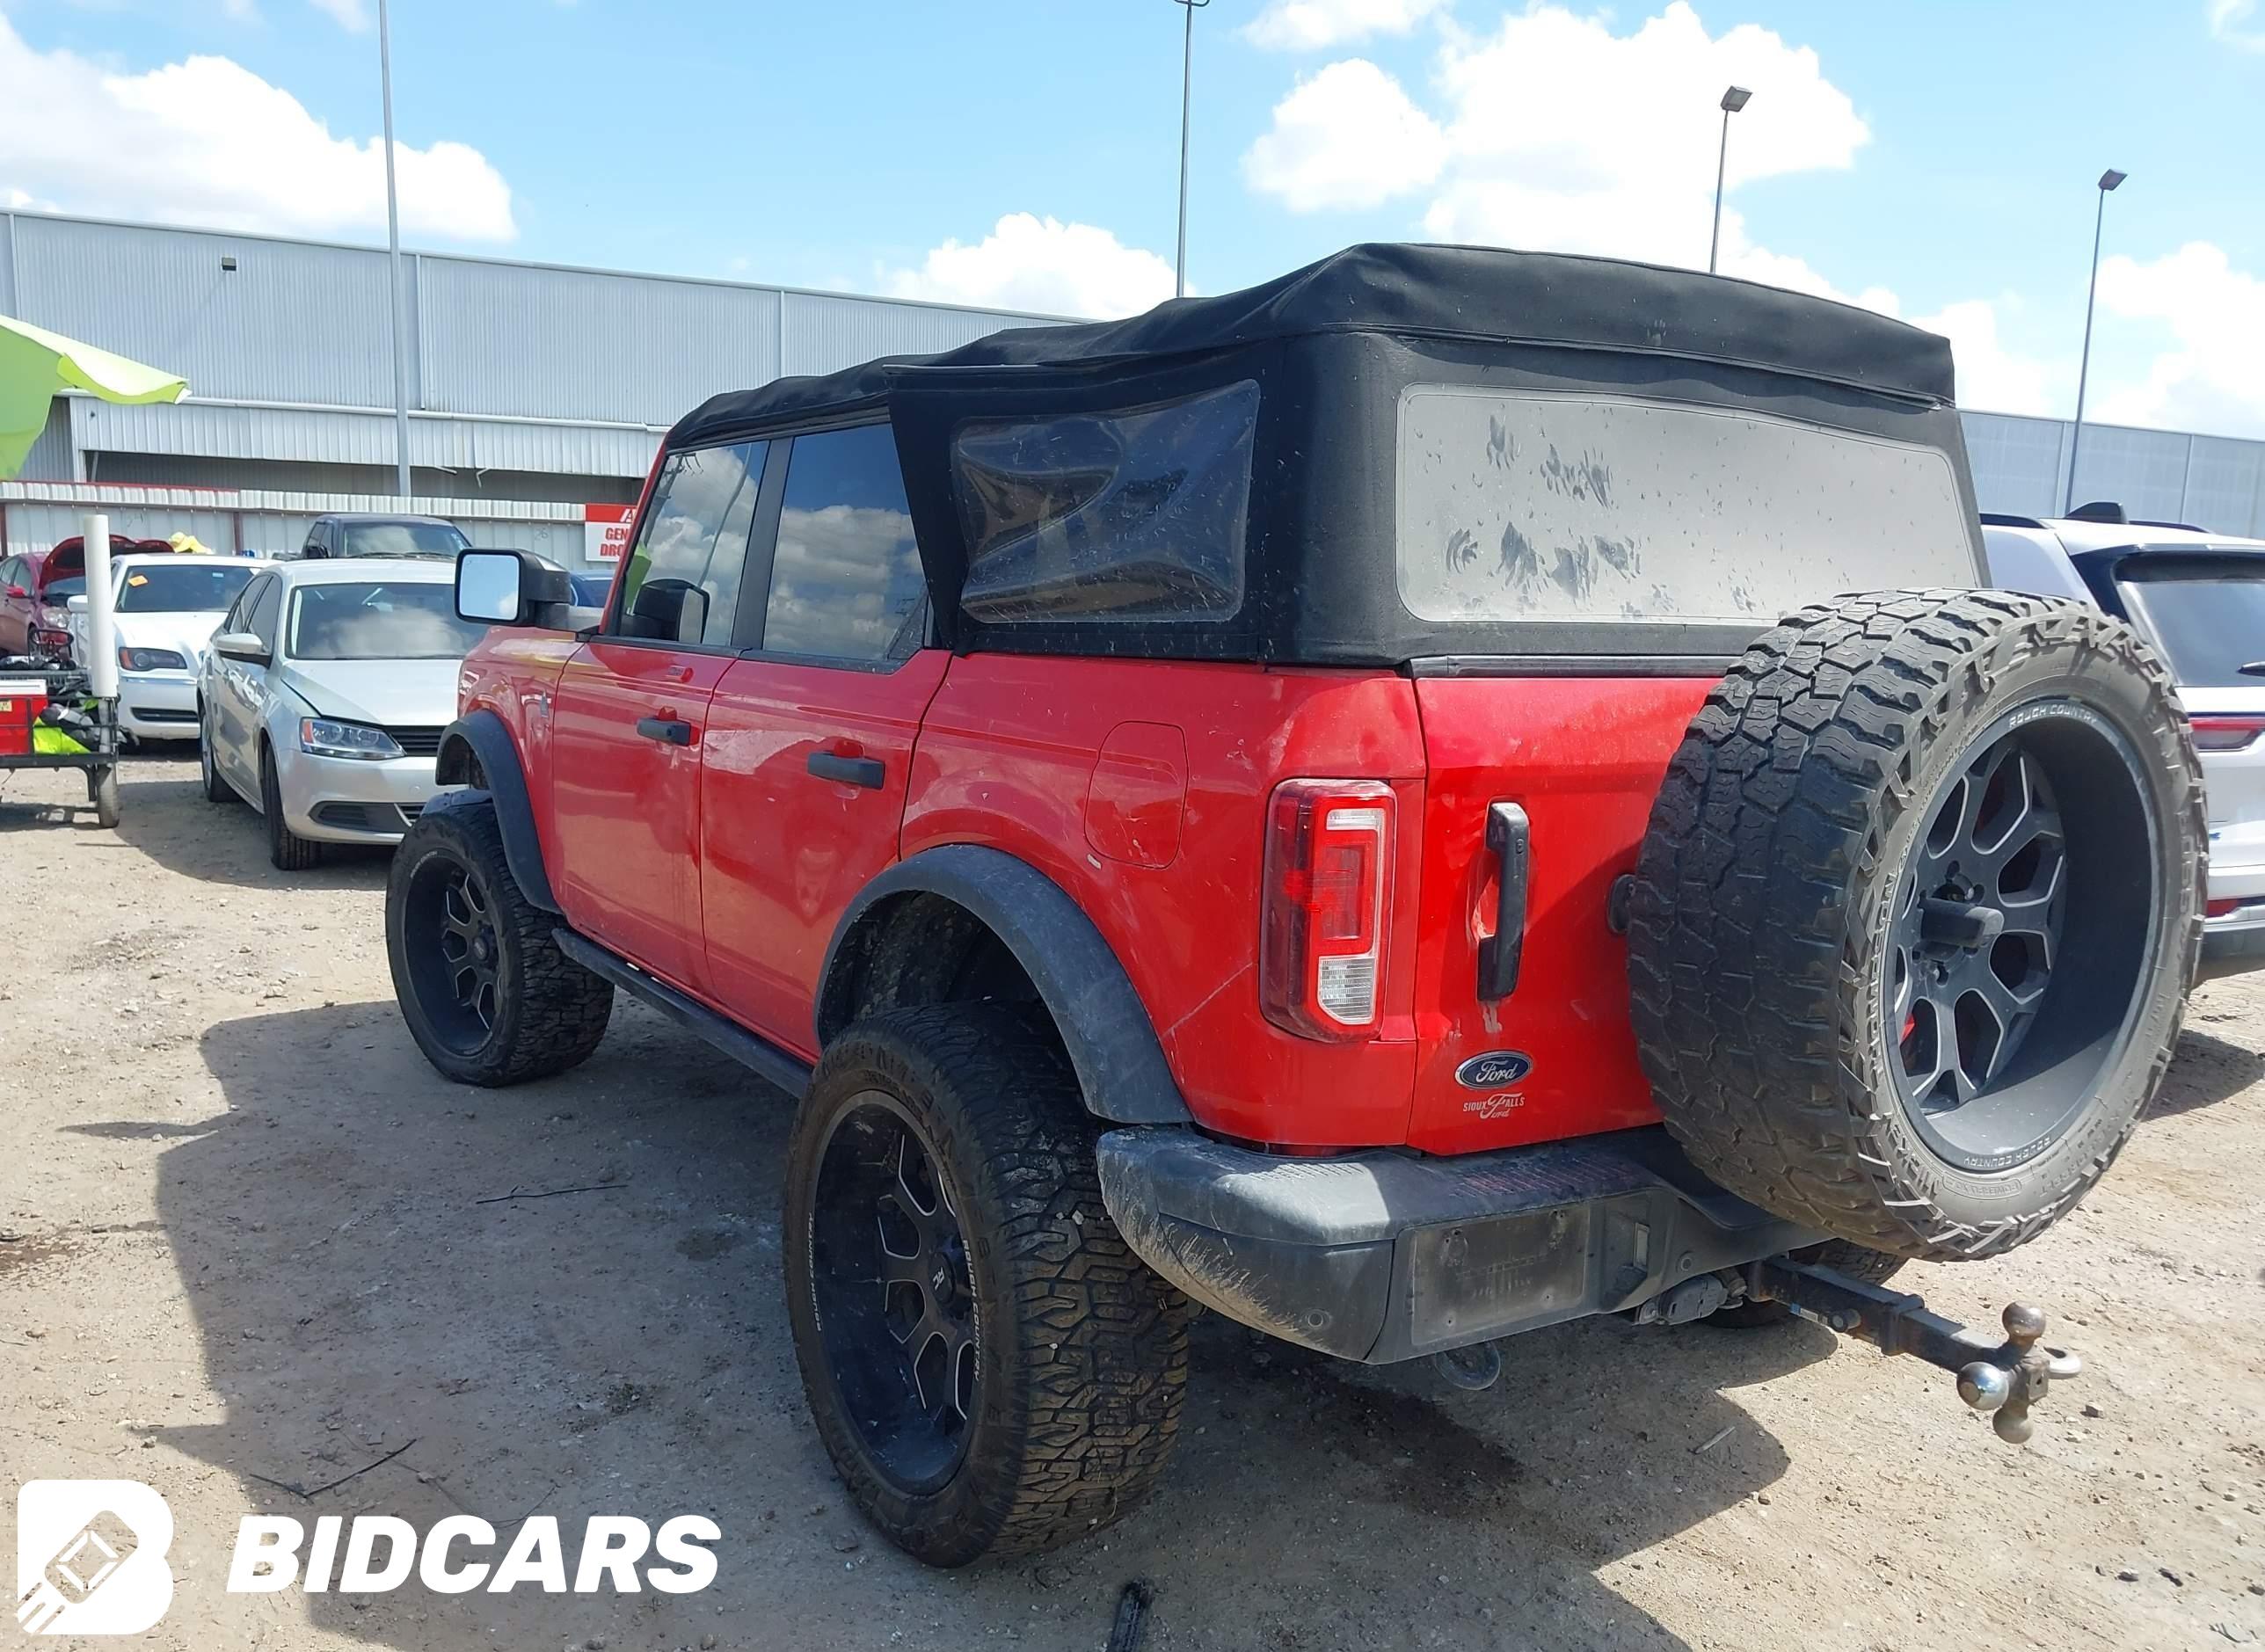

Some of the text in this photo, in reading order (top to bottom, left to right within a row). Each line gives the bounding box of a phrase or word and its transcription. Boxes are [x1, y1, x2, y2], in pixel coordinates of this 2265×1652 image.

[605, 528, 629, 541] GEN
[600, 543, 625, 557] DRO
[2008, 705, 2047, 729] ROUGH
[1475, 1059, 1518, 1083] Ford
[1462, 1101, 1489, 1112] SIOUX
[962, 1239, 981, 1382] ROUGH COUNTRY
